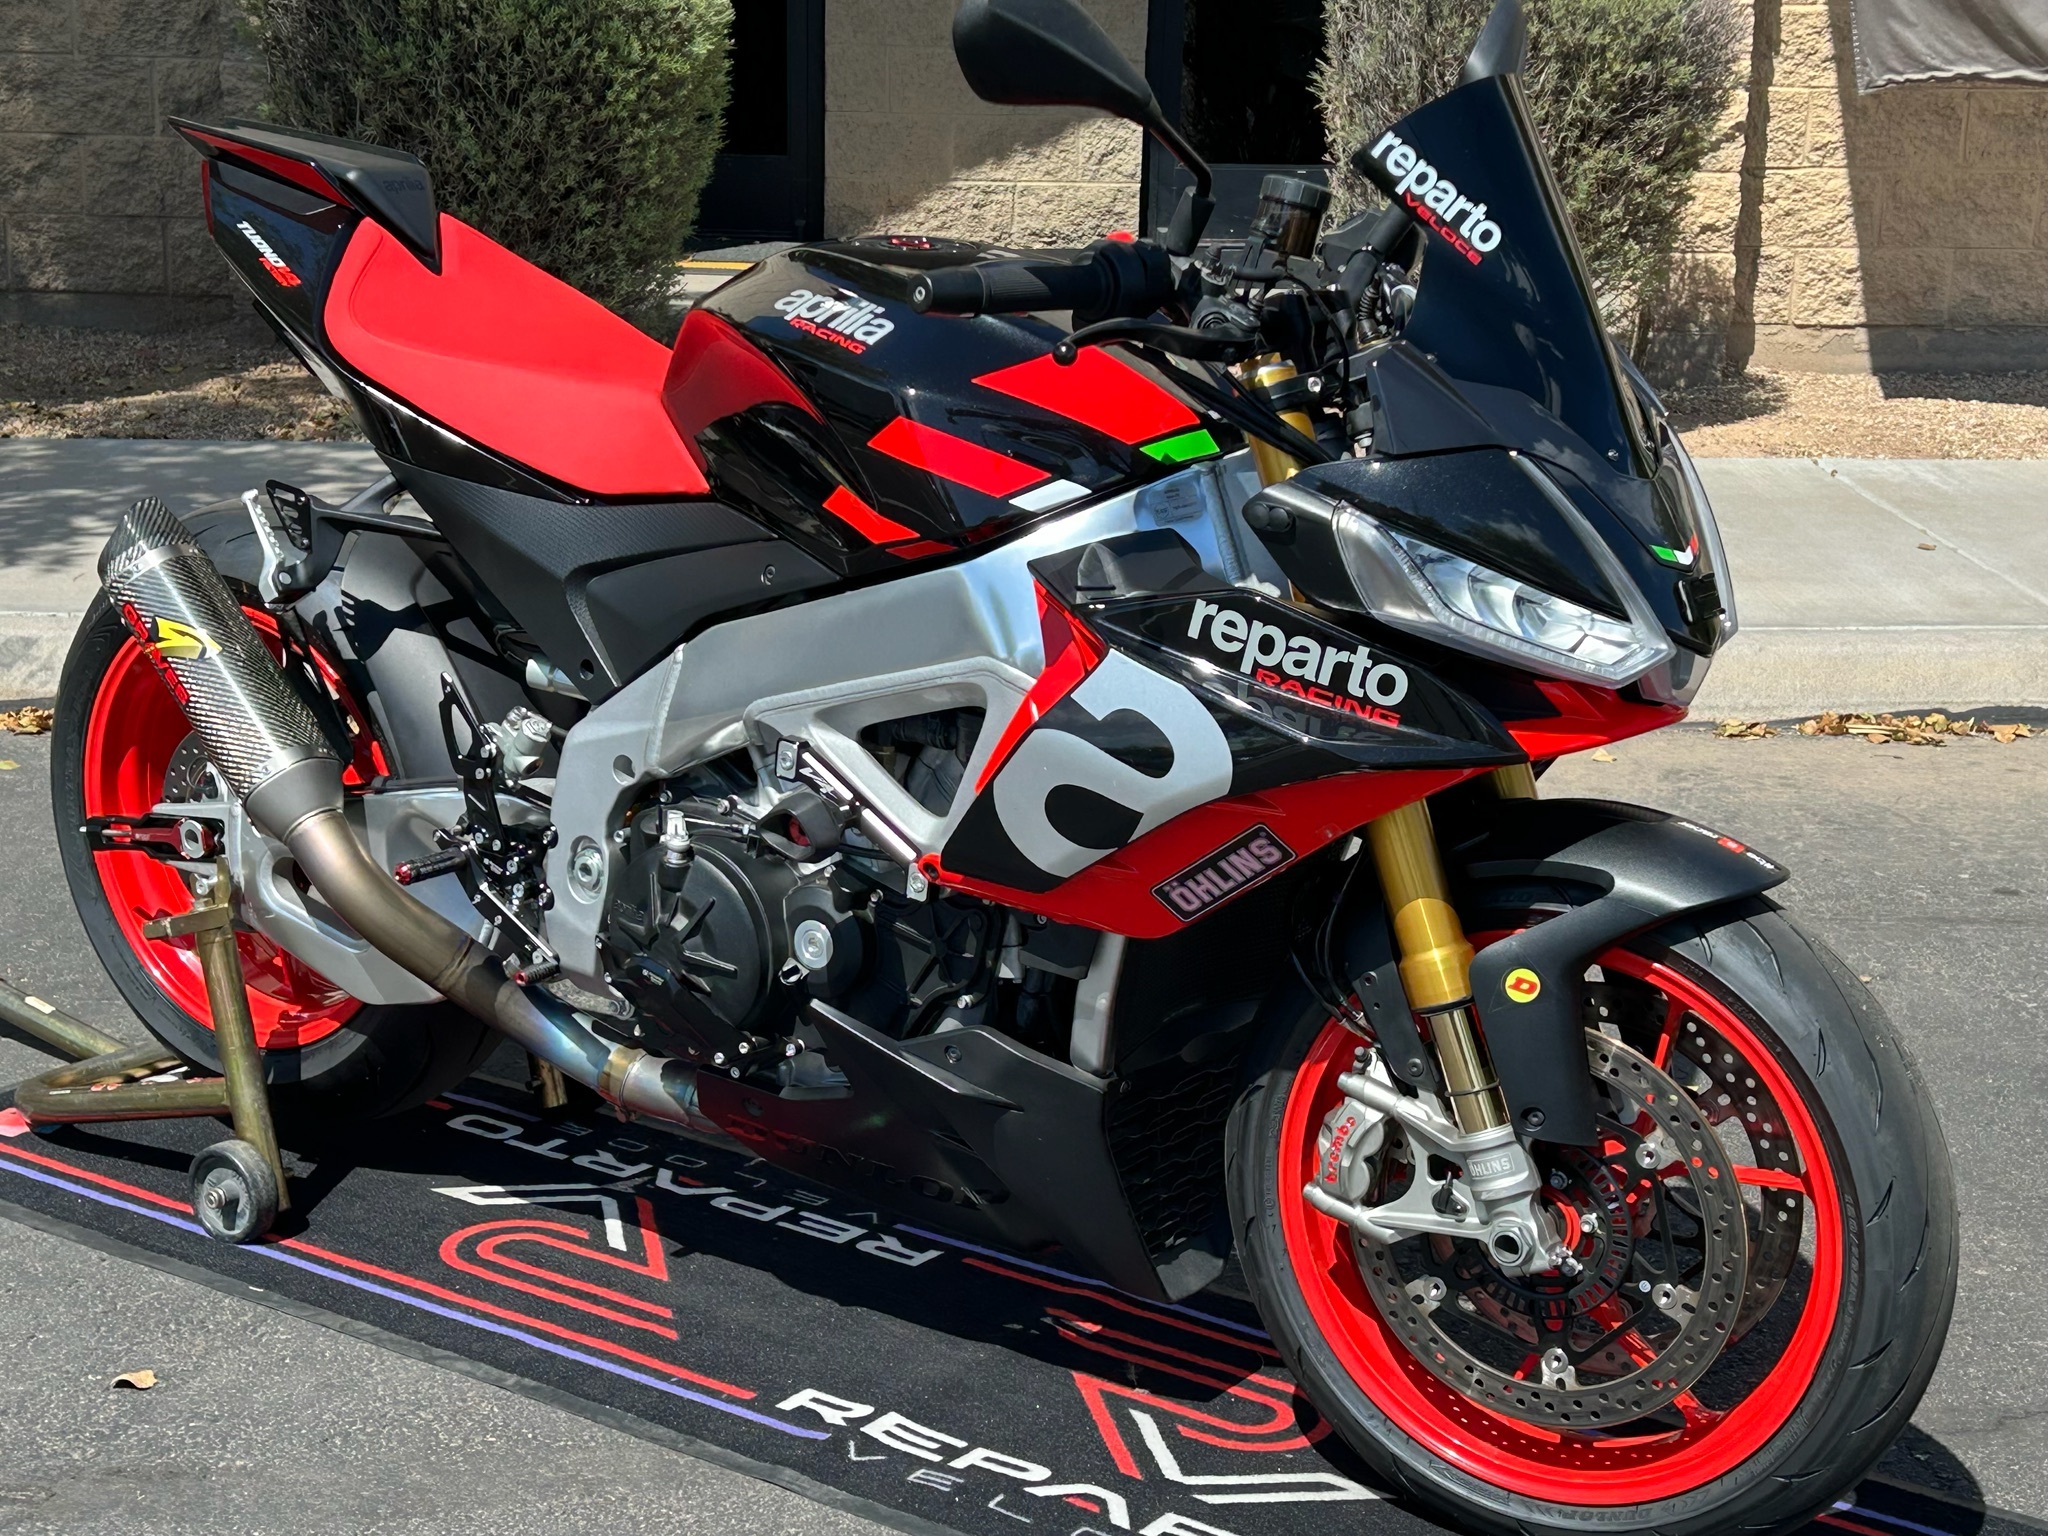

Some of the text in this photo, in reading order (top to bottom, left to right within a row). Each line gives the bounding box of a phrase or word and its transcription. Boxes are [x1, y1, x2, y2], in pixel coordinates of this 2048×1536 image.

[1370, 130, 1502, 253] reparto
[236, 220, 287, 268] TUONO
[1404, 192, 1482, 266] VELOCE
[774, 289, 895, 346] aprilia
[789, 317, 867, 355] RACING
[1187, 599, 1409, 706] reparto
[1255, 667, 1401, 728] RACING
[1162, 836, 1283, 913] ÖHLINS
[1323, 1116, 1356, 1184] brembo
[446, 1114, 945, 1268] REPARTO
[849, 1440, 1117, 1536] VEL
